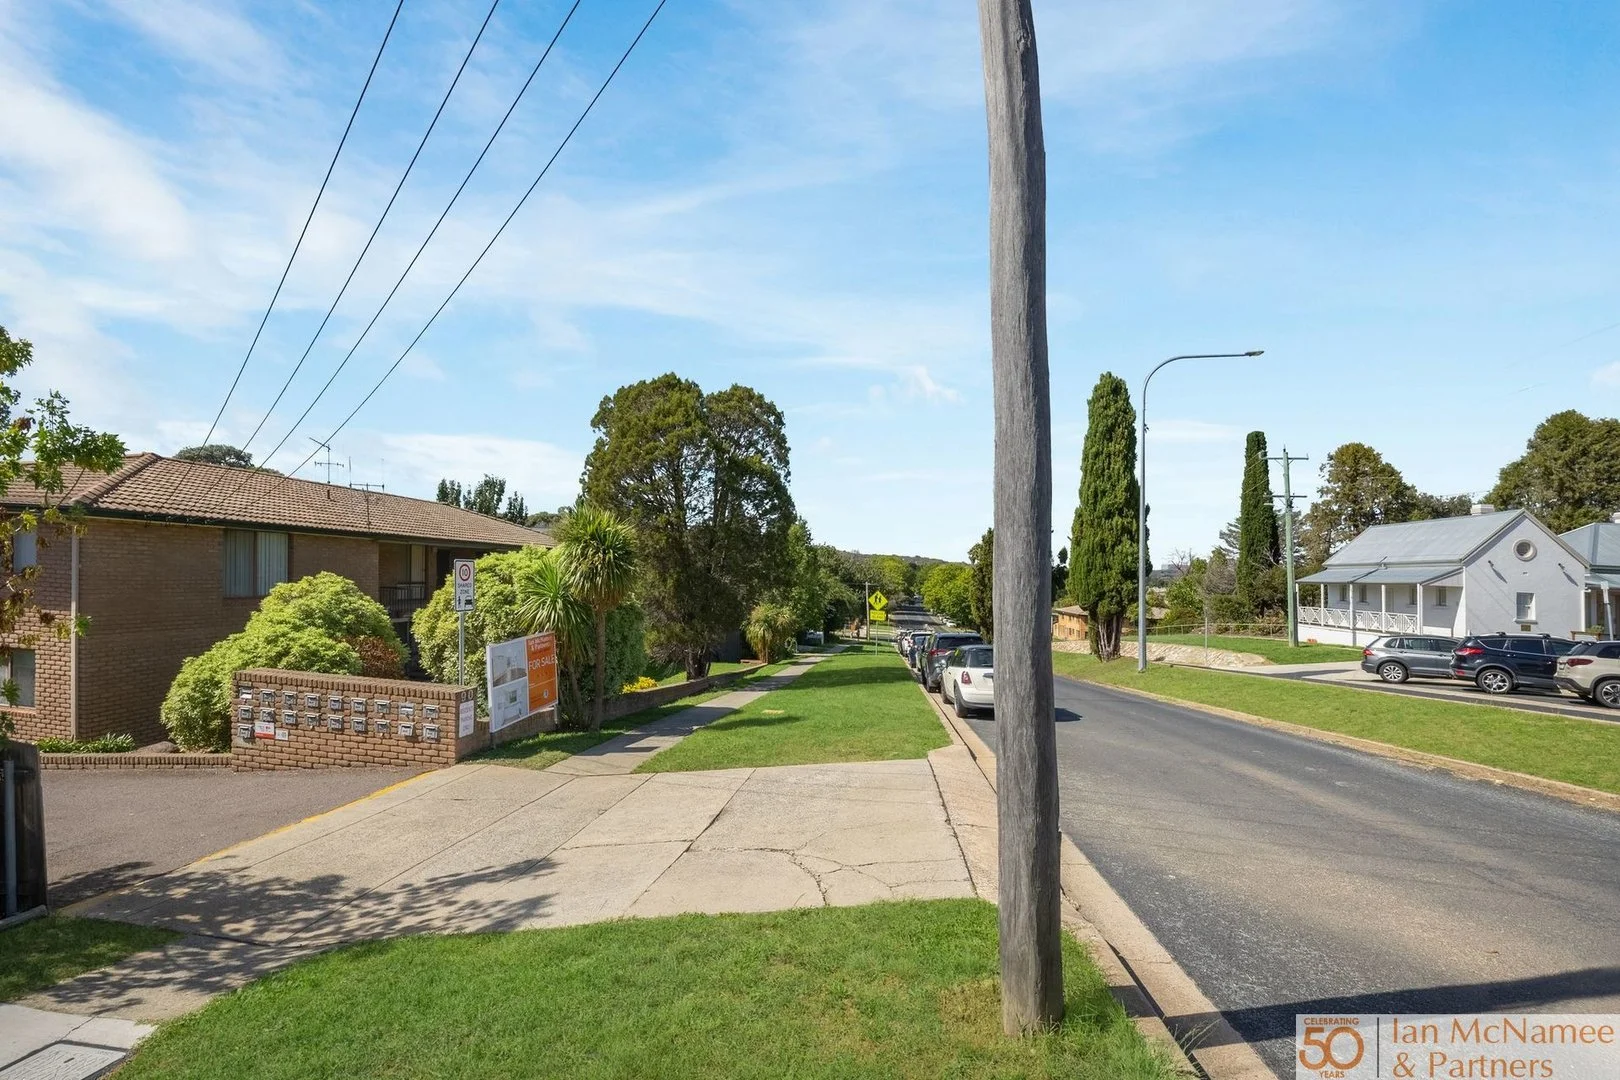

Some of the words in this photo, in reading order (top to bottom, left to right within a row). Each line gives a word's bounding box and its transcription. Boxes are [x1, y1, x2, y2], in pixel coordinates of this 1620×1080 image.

[462, 568, 469, 577] 10
[529, 659, 540, 670] FOR
[541, 654, 555, 667] SALE
[461, 690, 473, 702] 90
